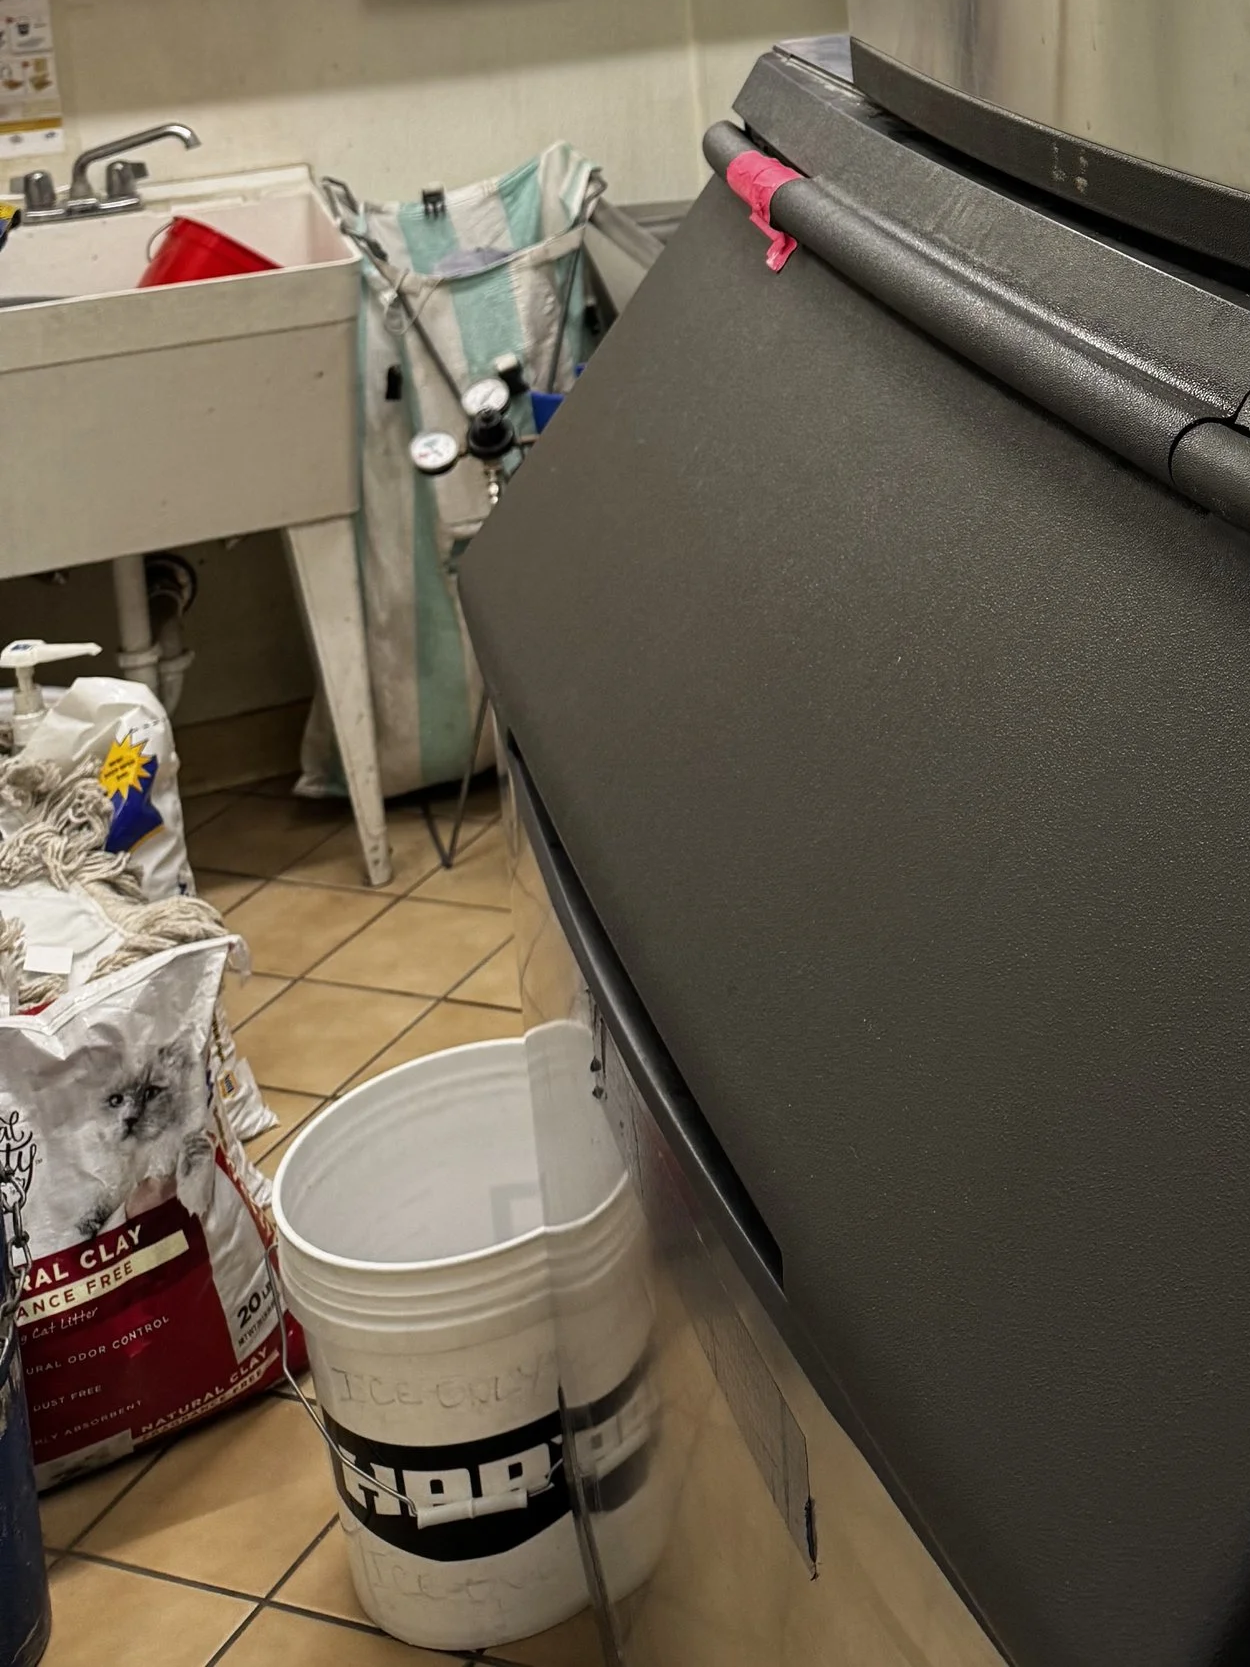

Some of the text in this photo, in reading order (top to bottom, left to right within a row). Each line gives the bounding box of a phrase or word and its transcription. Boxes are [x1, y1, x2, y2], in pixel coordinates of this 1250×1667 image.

[79, 1224, 142, 1270] CLAY
[86, 1260, 134, 1295] FREE
[32, 1321, 57, 1340] Cat
[60, 1307, 98, 1330] Litter
[237, 1291, 261, 1329] 20
[68, 1345, 106, 1364] ODOR
[112, 1315, 170, 1350] CONTROL
[33, 1384, 103, 1412] DUST FREE
[141, 1346, 267, 1433] NATURAL CLAY
[64, 1399, 143, 1436] ABSORBENT
